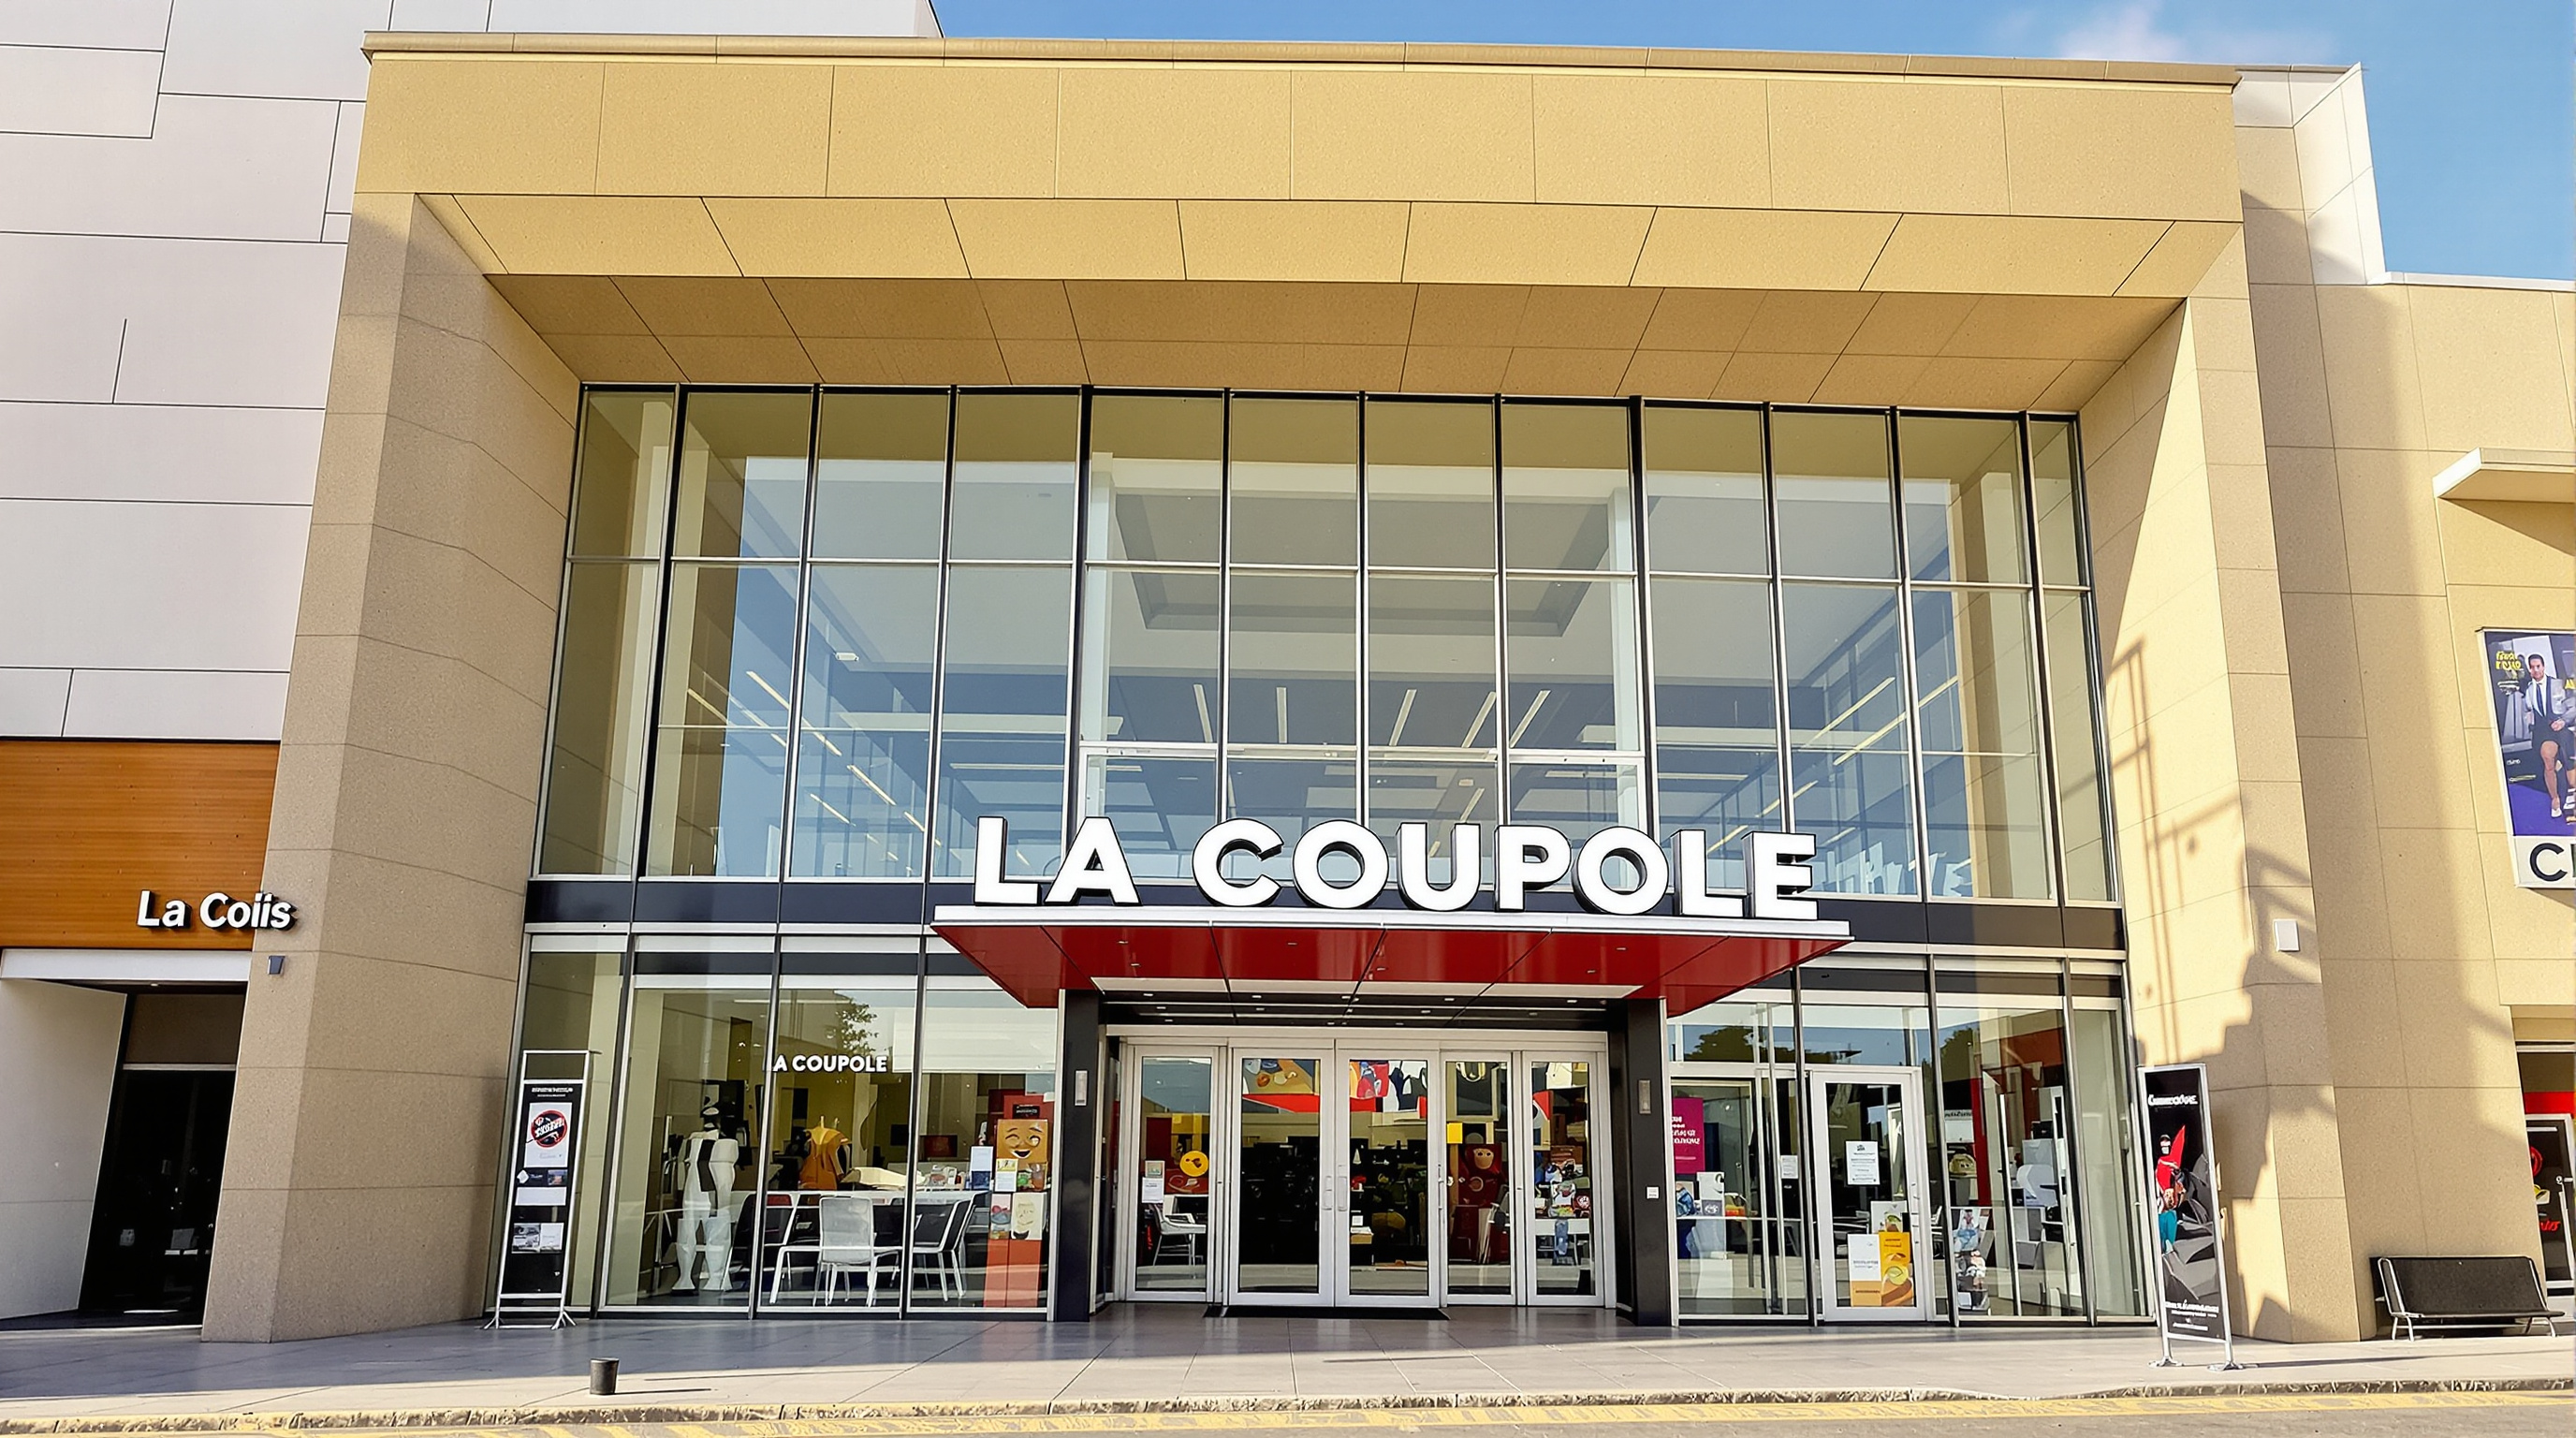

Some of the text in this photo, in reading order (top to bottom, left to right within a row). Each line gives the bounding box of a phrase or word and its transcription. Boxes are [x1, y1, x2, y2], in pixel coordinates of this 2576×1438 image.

[973, 815, 1820, 920] LA COUPOLE
[137, 889, 188, 929] La
[792, 1054, 888, 1073] COUPOLE
